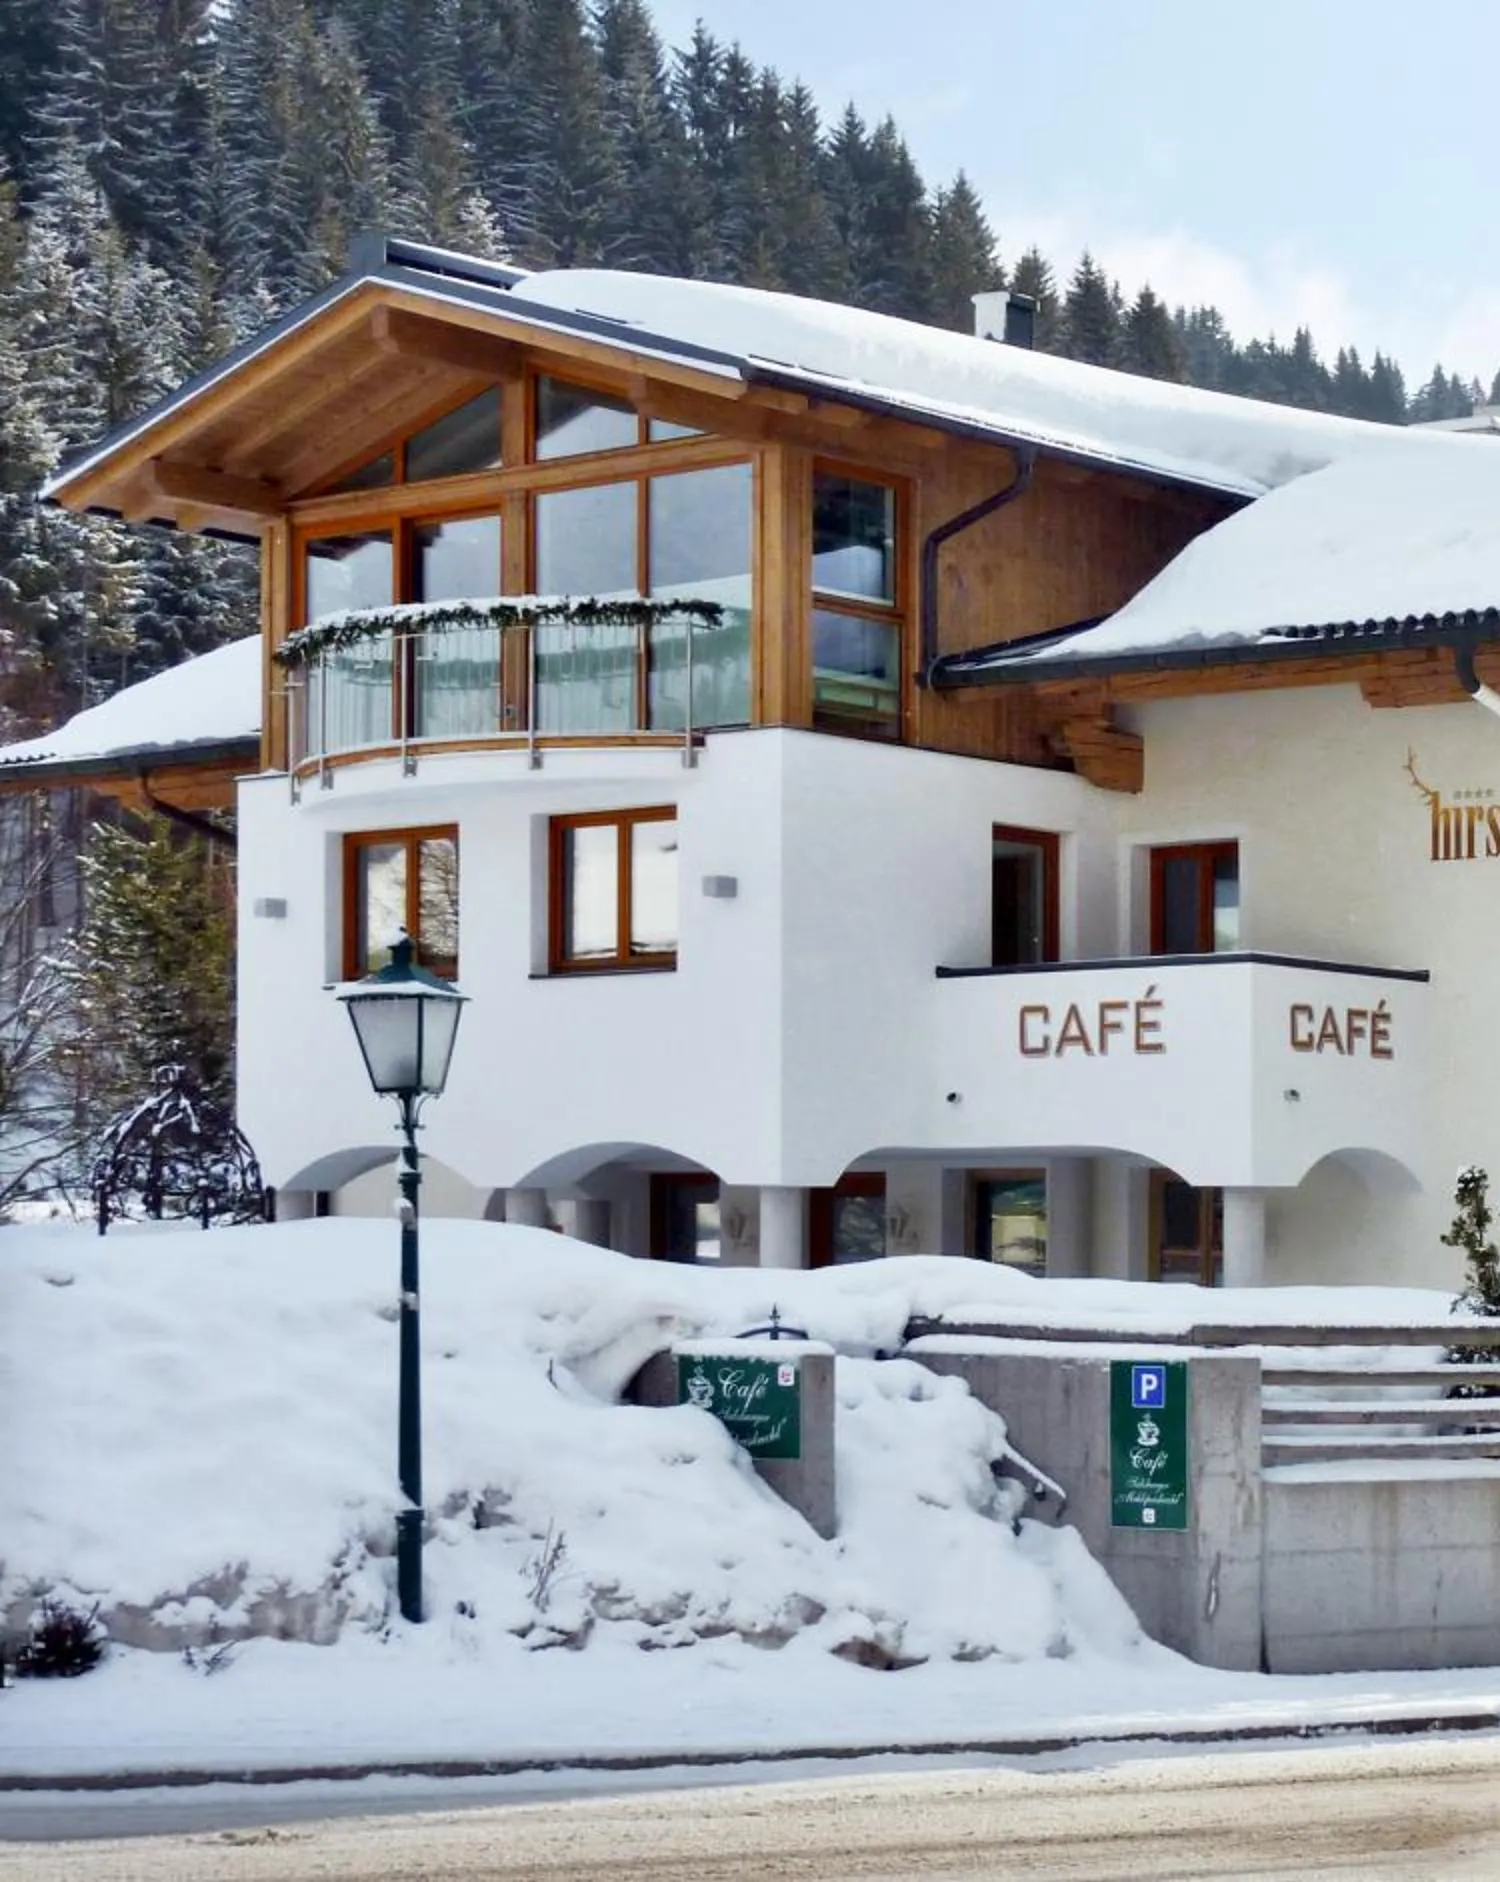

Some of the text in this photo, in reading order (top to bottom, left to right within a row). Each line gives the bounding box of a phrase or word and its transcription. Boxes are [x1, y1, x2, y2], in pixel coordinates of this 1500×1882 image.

[1018, 985, 1166, 1058] CAFÉ
[1290, 1000, 1394, 1058] CAFÉ
[717, 1368, 770, 1412] Café
[1140, 1373, 1158, 1400] P
[1129, 1448, 1168, 1475] Café
